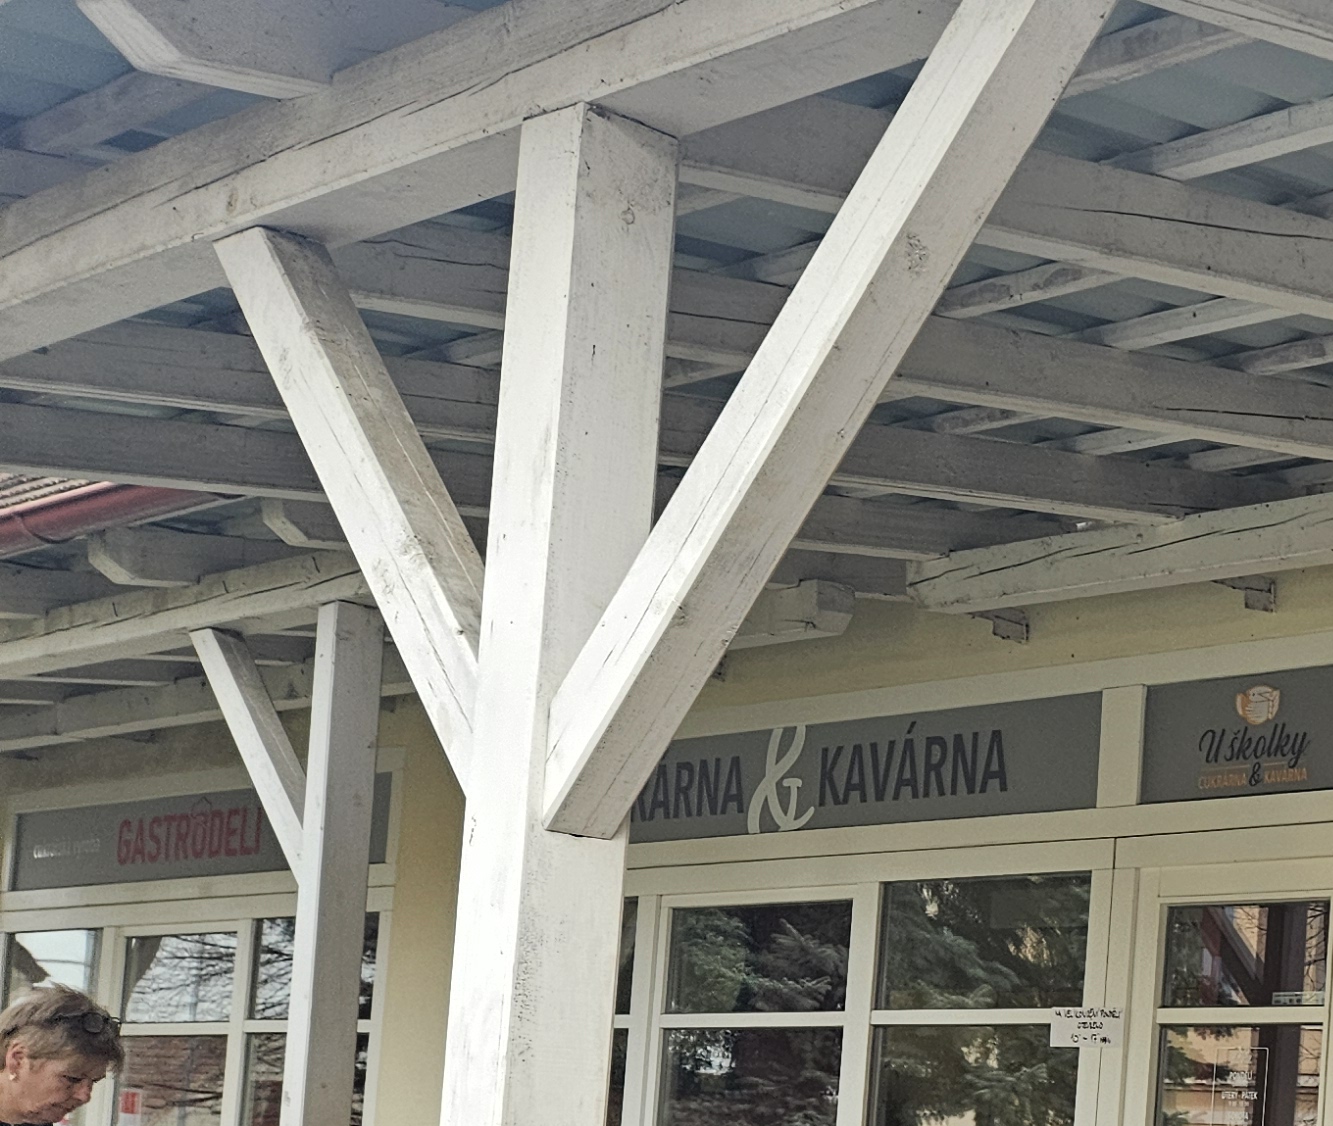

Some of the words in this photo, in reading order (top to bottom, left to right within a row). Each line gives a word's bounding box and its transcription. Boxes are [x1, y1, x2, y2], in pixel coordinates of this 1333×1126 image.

[1199, 728, 1226, 763] U
[1224, 722, 1310, 769] školky
[747, 725, 815, 833] &
[818, 721, 1008, 807] KAVÁRNA
[1249, 761, 1262, 786] &
[116, 806, 263, 866] GASTRODELI
